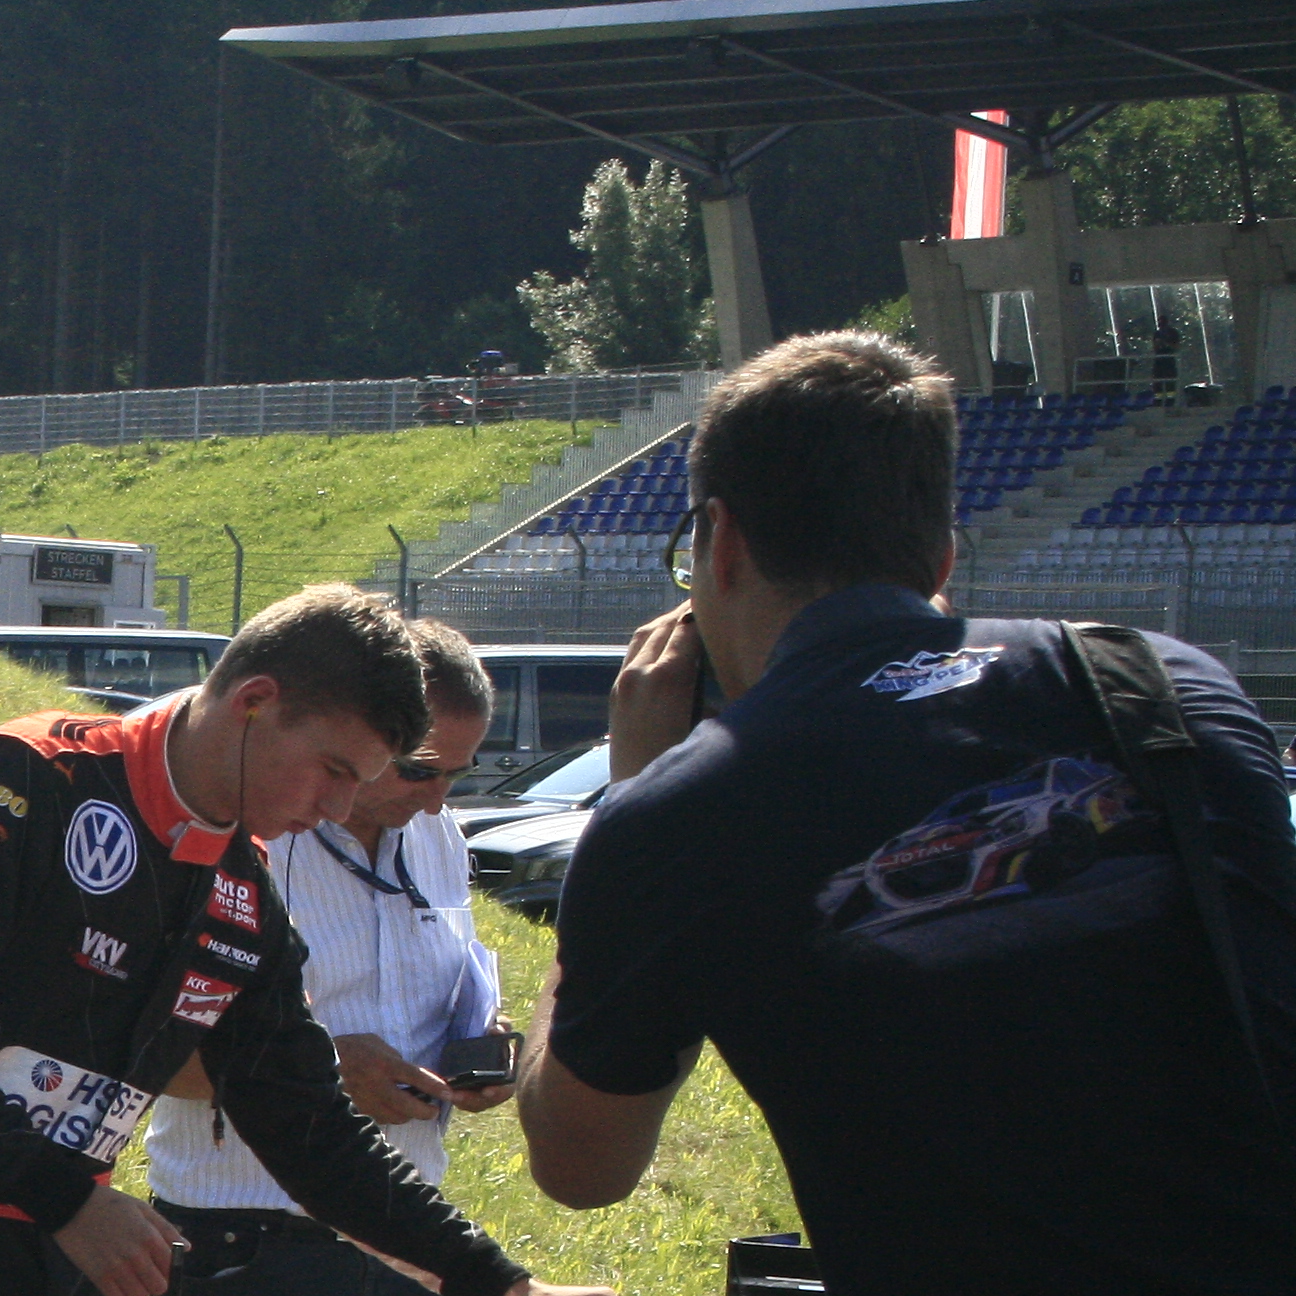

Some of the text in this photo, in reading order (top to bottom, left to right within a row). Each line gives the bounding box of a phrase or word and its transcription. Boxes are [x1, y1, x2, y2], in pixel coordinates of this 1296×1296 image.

[47, 552, 105, 566] STRECKEN
[51, 567, 99, 582] STAFFEL
[81, 926, 128, 967] VKV
[186, 976, 212, 993] KFC
